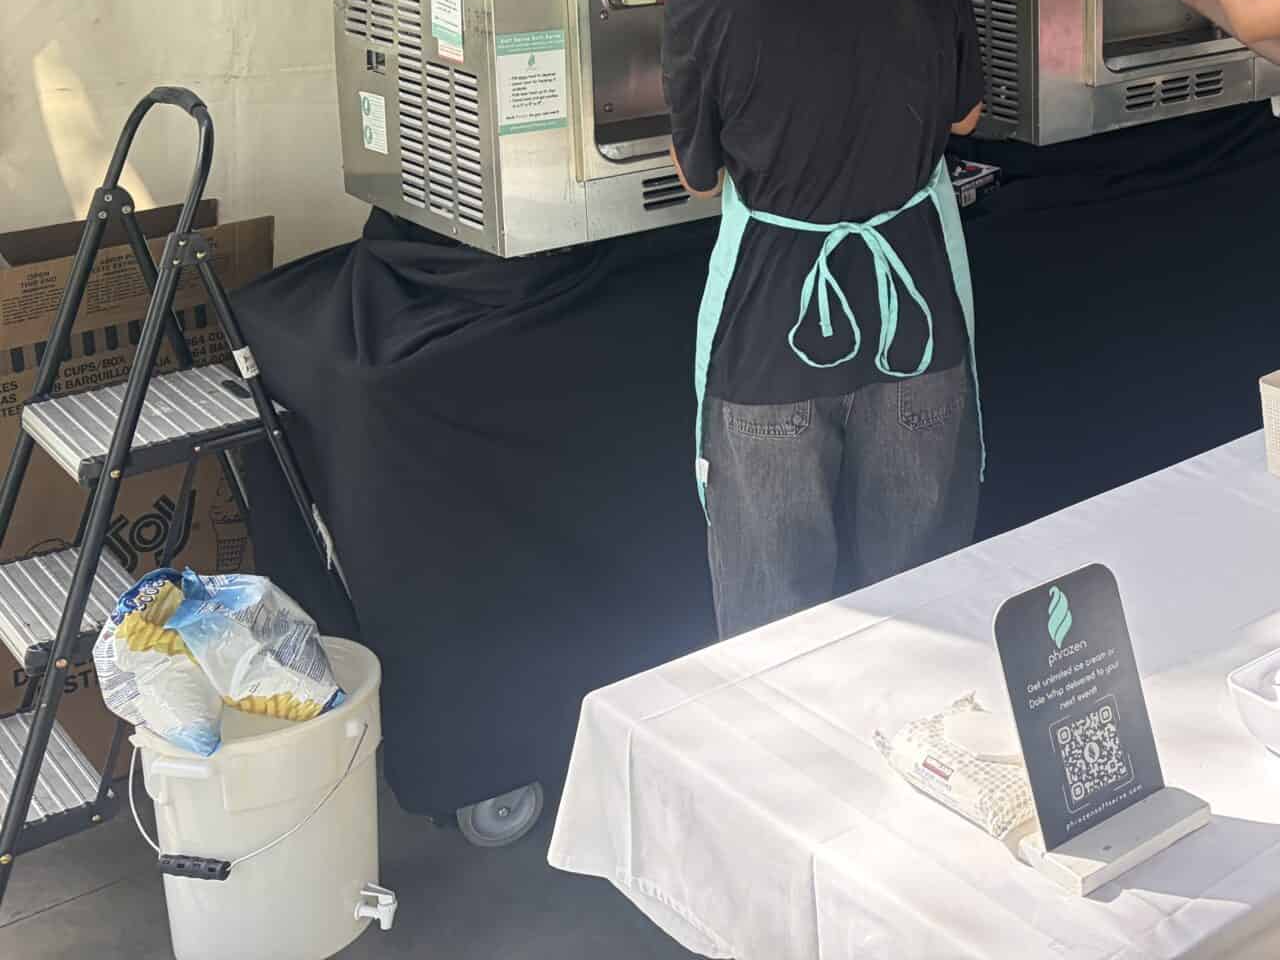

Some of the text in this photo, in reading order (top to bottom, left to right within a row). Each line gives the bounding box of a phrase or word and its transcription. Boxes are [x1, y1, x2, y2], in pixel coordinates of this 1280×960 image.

[63, 355, 125, 379] CUPS/BOX
[1049, 640, 1088, 668] phrozen
[1027, 680, 1041, 693] Get
[1042, 664, 1072, 687] unlimited
[1073, 661, 1084, 672] ice
[1085, 651, 1106, 667] cream
[1029, 695, 1046, 710] Dole
[1065, 670, 1096, 691] delivered
[1096, 666, 1105, 677] to
[1059, 694, 1077, 711] next
